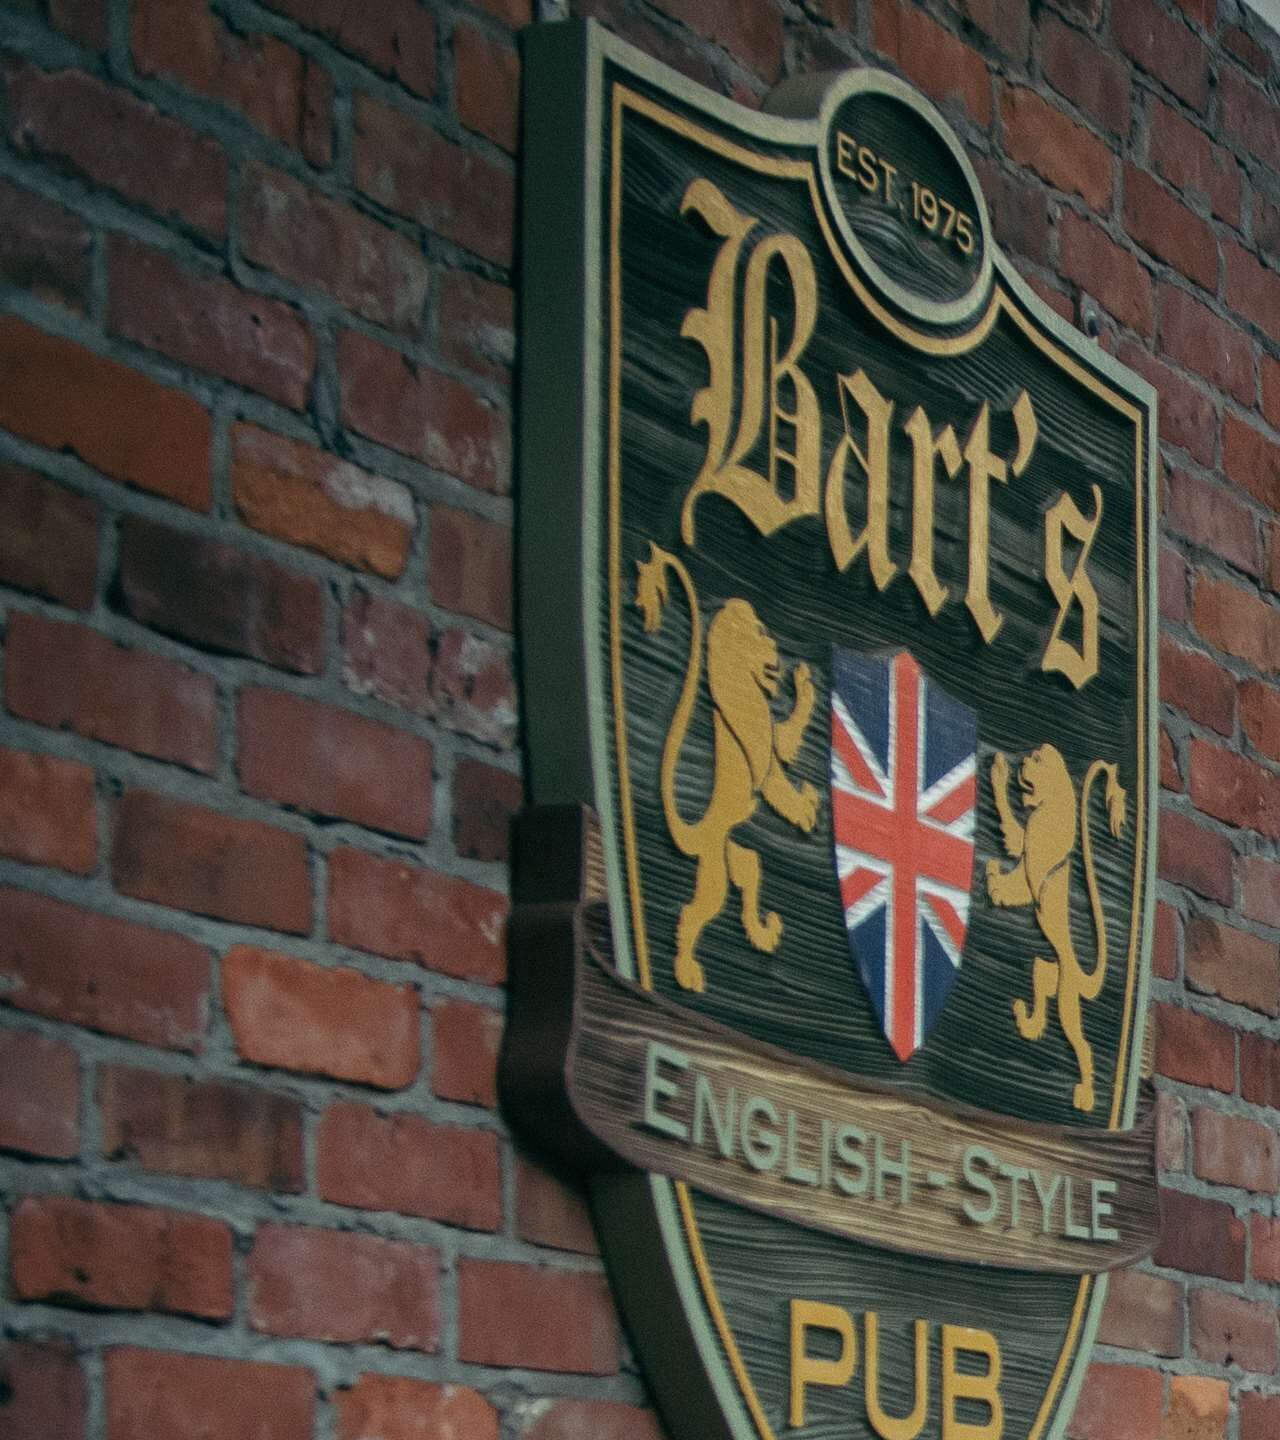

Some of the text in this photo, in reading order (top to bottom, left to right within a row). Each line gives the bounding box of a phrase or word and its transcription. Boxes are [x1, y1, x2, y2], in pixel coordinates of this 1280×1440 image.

[836, 130, 975, 254] EST. 1975
[680, 177, 1102, 691] Bart's
